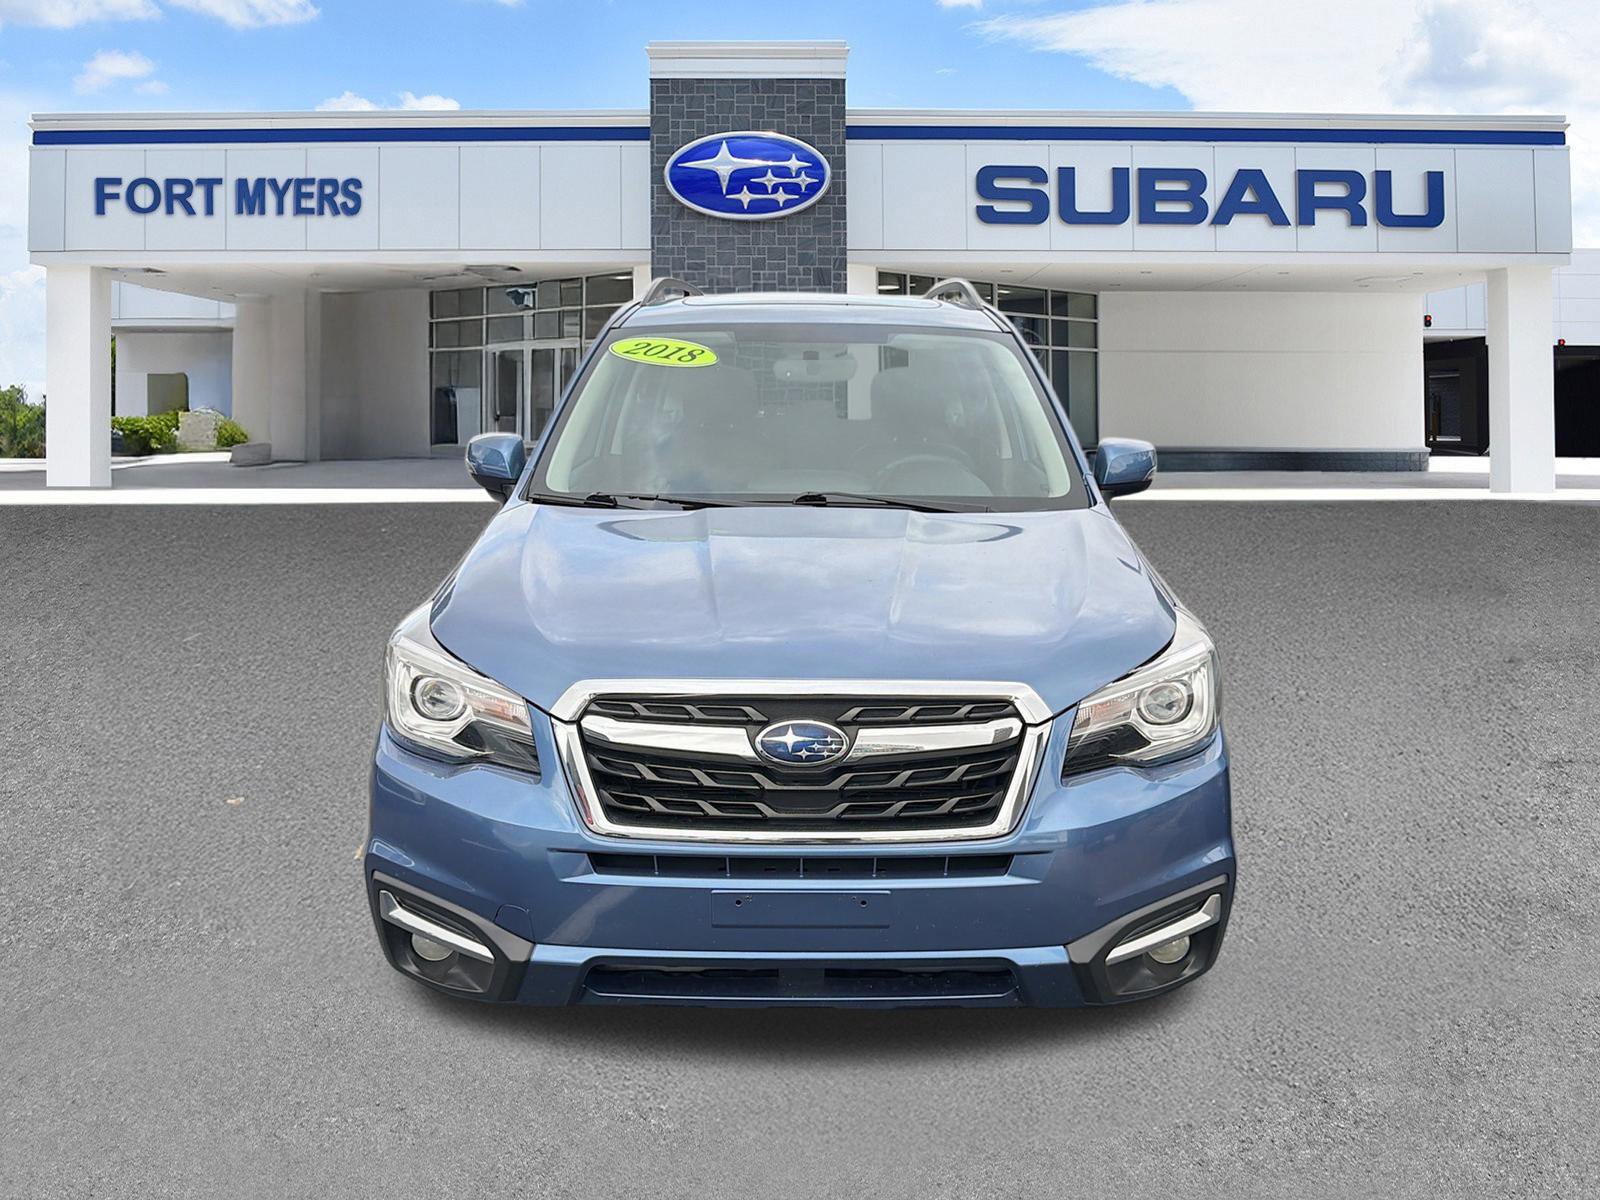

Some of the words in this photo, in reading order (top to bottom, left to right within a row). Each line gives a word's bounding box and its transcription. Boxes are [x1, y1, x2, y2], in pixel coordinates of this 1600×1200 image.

[94, 177, 223, 217] FORT
[234, 177, 363, 217] MYERS
[975, 165, 1445, 228] SUBARU
[621, 341, 705, 363] 2018
